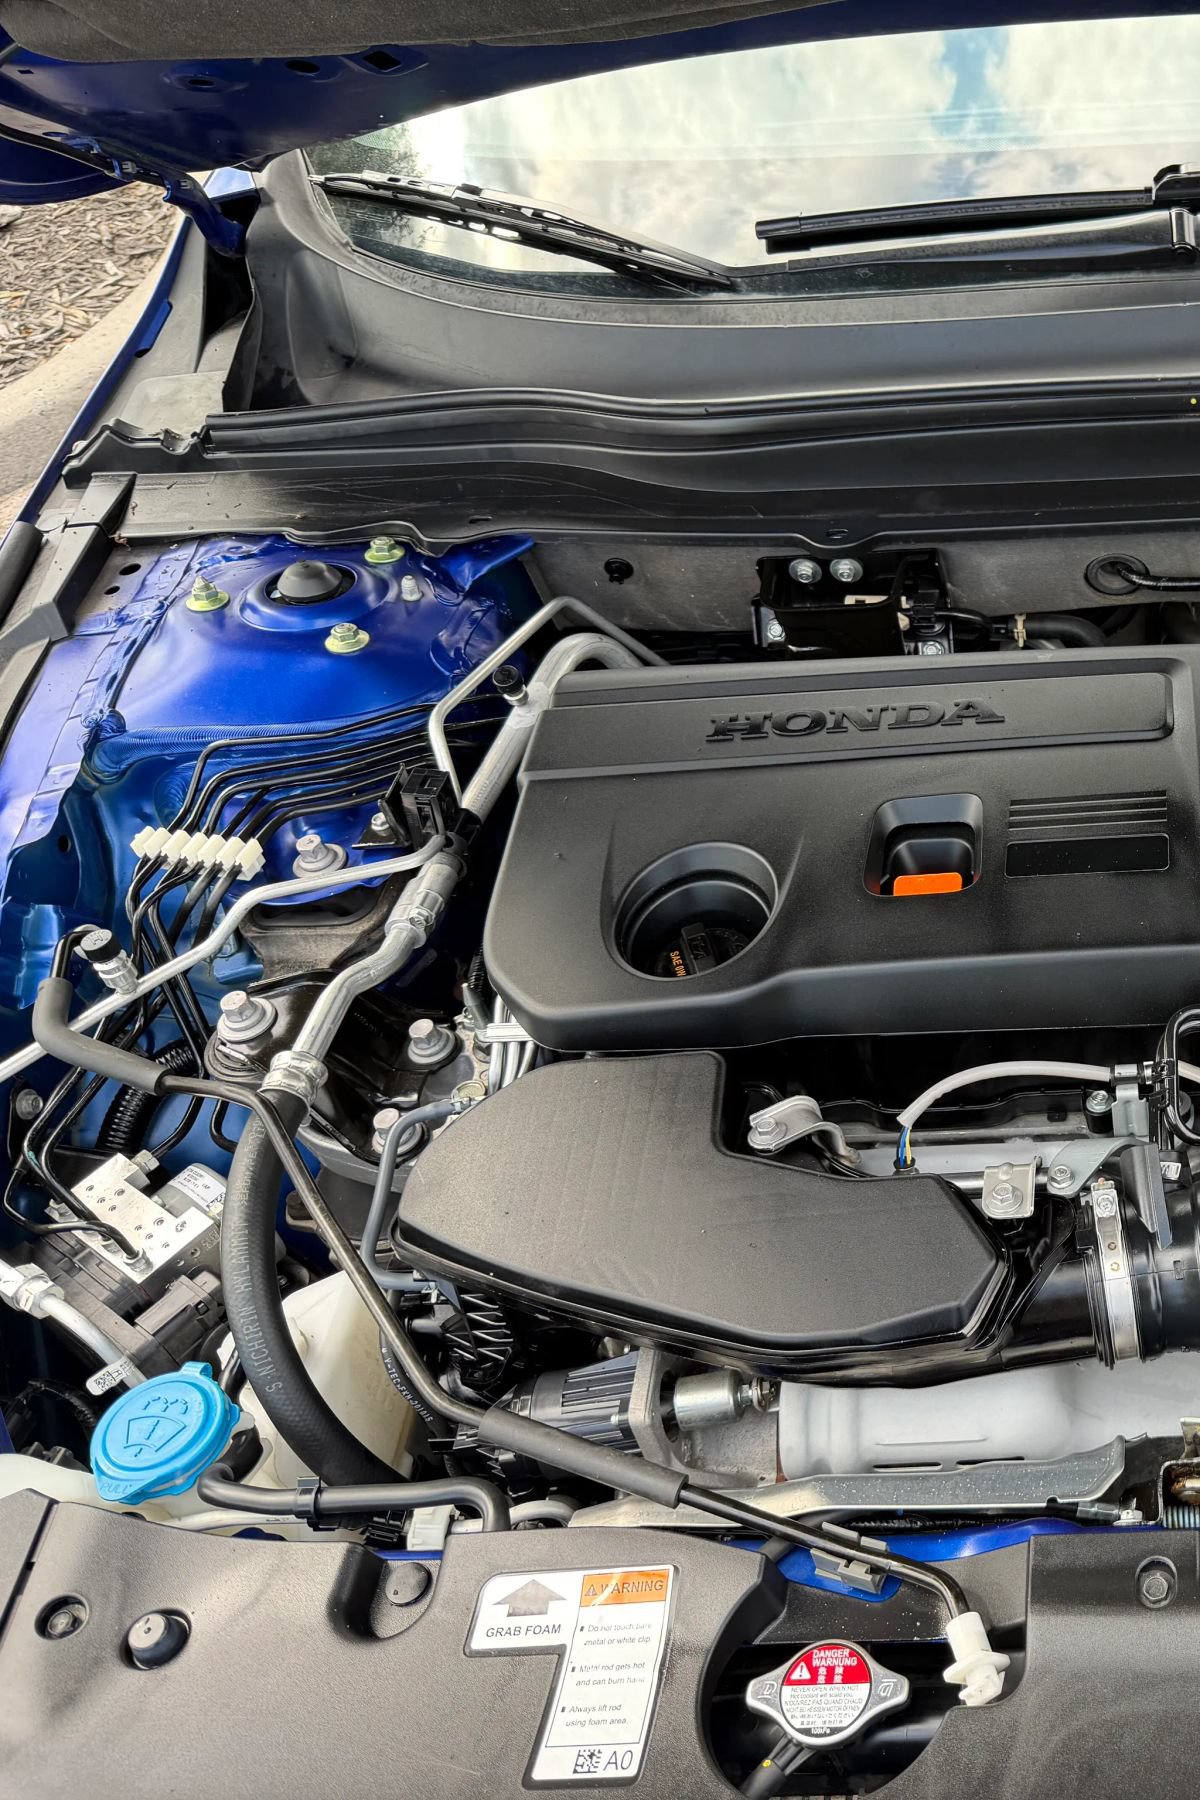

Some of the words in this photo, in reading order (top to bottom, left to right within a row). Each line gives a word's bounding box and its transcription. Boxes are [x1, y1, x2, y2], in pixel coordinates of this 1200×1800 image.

[705, 698, 1005, 743] HONDA
[670, 950, 683, 966] SAE
[600, 1579, 665, 1595] WARNING
[485, 1625, 522, 1638] GRAB
[524, 1623, 562, 1637] FOAM
[587, 1624, 599, 1633] Do
[616, 1636, 637, 1645] white
[812, 1649, 850, 1658] DANGER
[601, 1663, 614, 1672] rod
[615, 1663, 631, 1673] gets
[632, 1661, 646, 1670] hot
[812, 1657, 858, 1667] WARNUNG
[575, 1678, 591, 1687] and
[592, 1678, 606, 1686] can
[607, 1676, 625, 1686] burn
[568, 1704, 596, 1715] Always
[598, 1703, 608, 1713] lift
[608, 1703, 622, 1713] rod
[565, 1716, 587, 1728] using
[587, 1715, 608, 1726] foam
